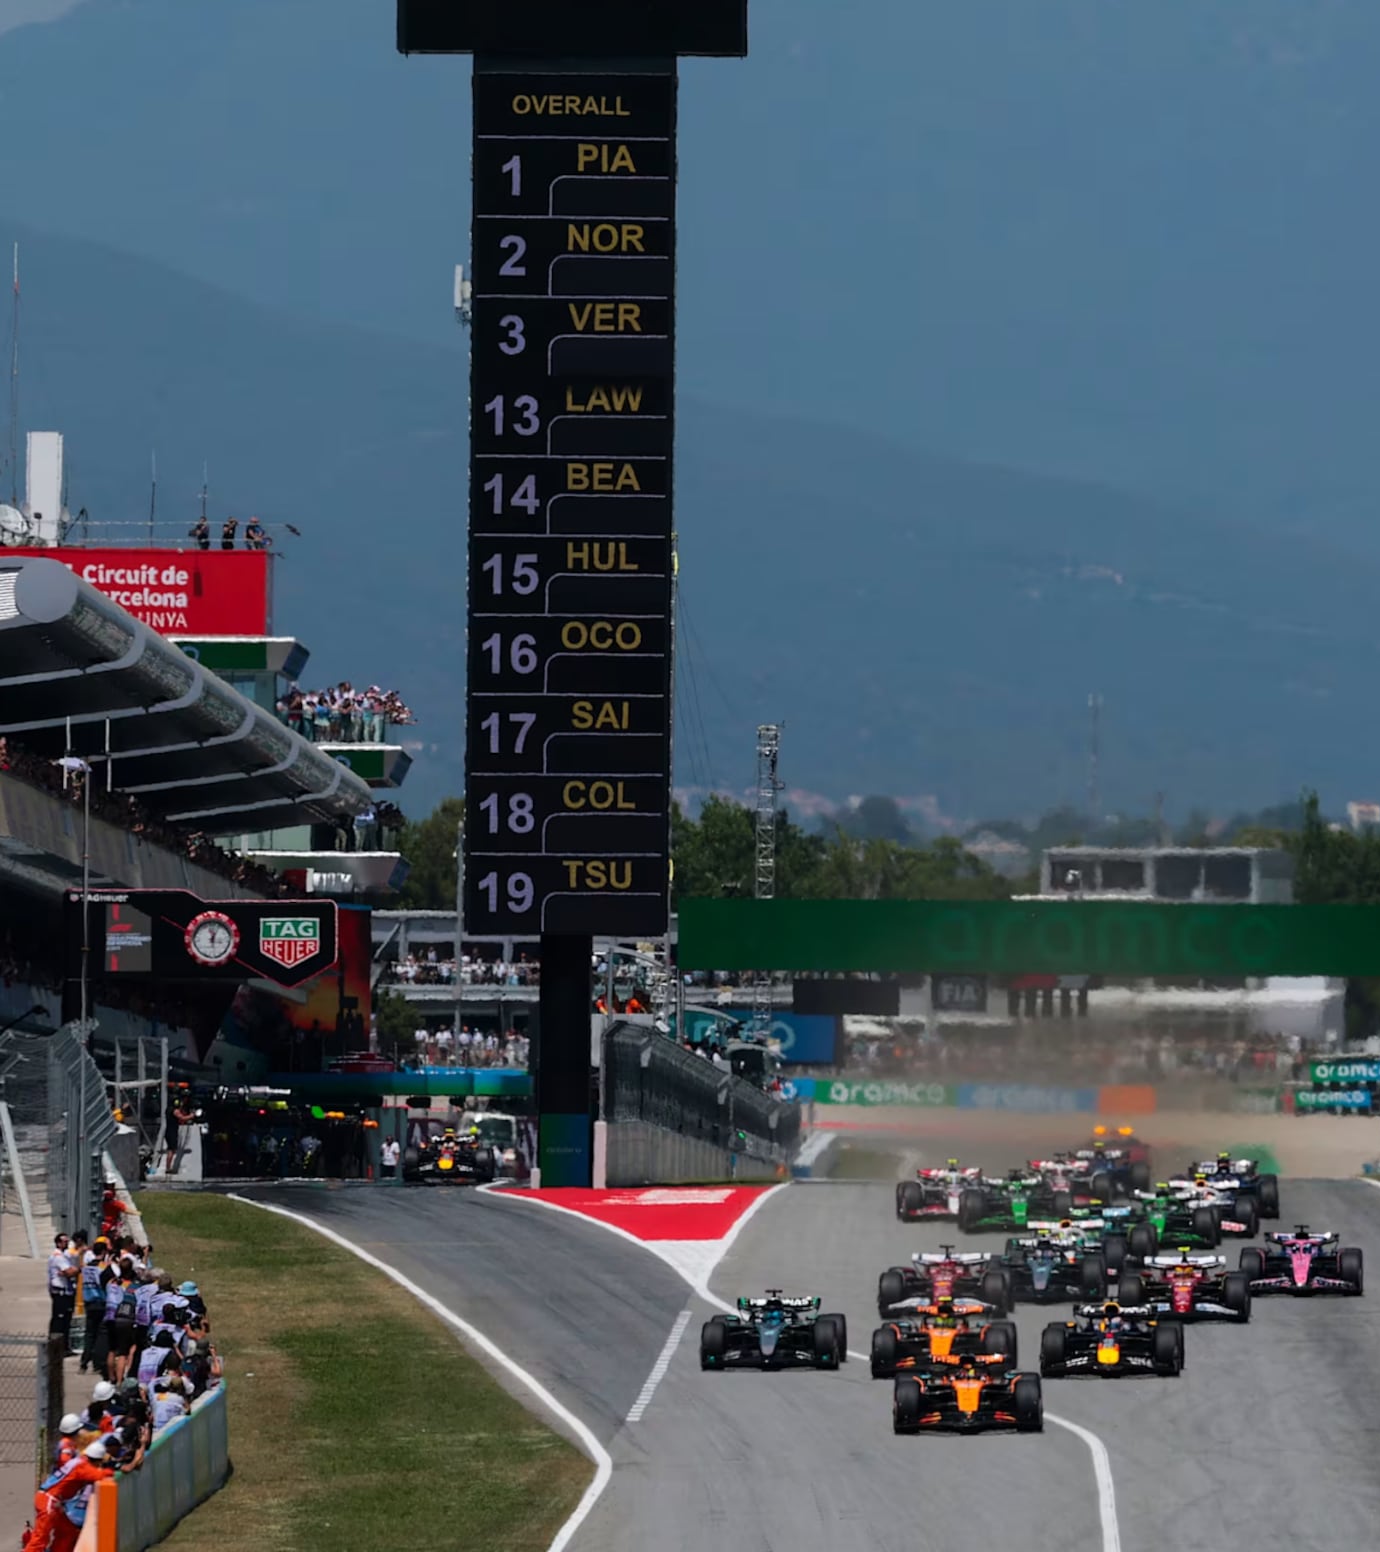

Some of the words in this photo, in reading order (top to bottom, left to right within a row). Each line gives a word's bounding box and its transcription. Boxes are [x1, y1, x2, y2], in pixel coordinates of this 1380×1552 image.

[512, 95, 630, 115] OVERALL
[502, 155, 521, 196] 1
[577, 143, 636, 173] PIA
[498, 235, 527, 276] 2
[567, 223, 644, 252] NOR
[498, 314, 526, 356] 3
[569, 303, 641, 332] VER
[484, 394, 540, 436] 13
[567, 386, 642, 412] LAW
[484, 473, 540, 514] 14
[567, 463, 641, 490] BEA
[82, 564, 158, 585] Circuit
[161, 565, 189, 586] de
[482, 553, 539, 595] 15
[567, 542, 638, 570] HUL
[104, 588, 188, 608] rcelona
[482, 632, 538, 674] 16
[561, 621, 642, 650] OCO
[481, 712, 537, 754] 17
[572, 701, 629, 729] SAI
[479, 792, 535, 834] 18
[563, 781, 636, 809] COL
[478, 871, 534, 913] 19
[562, 860, 632, 889] TSU
[263, 941, 318, 963] HEUER
[265, 921, 314, 937] TAG
[928, 909, 1281, 965] aramco
[830, 1082, 945, 1103] aramco
[1299, 1091, 1365, 1104] aramco
